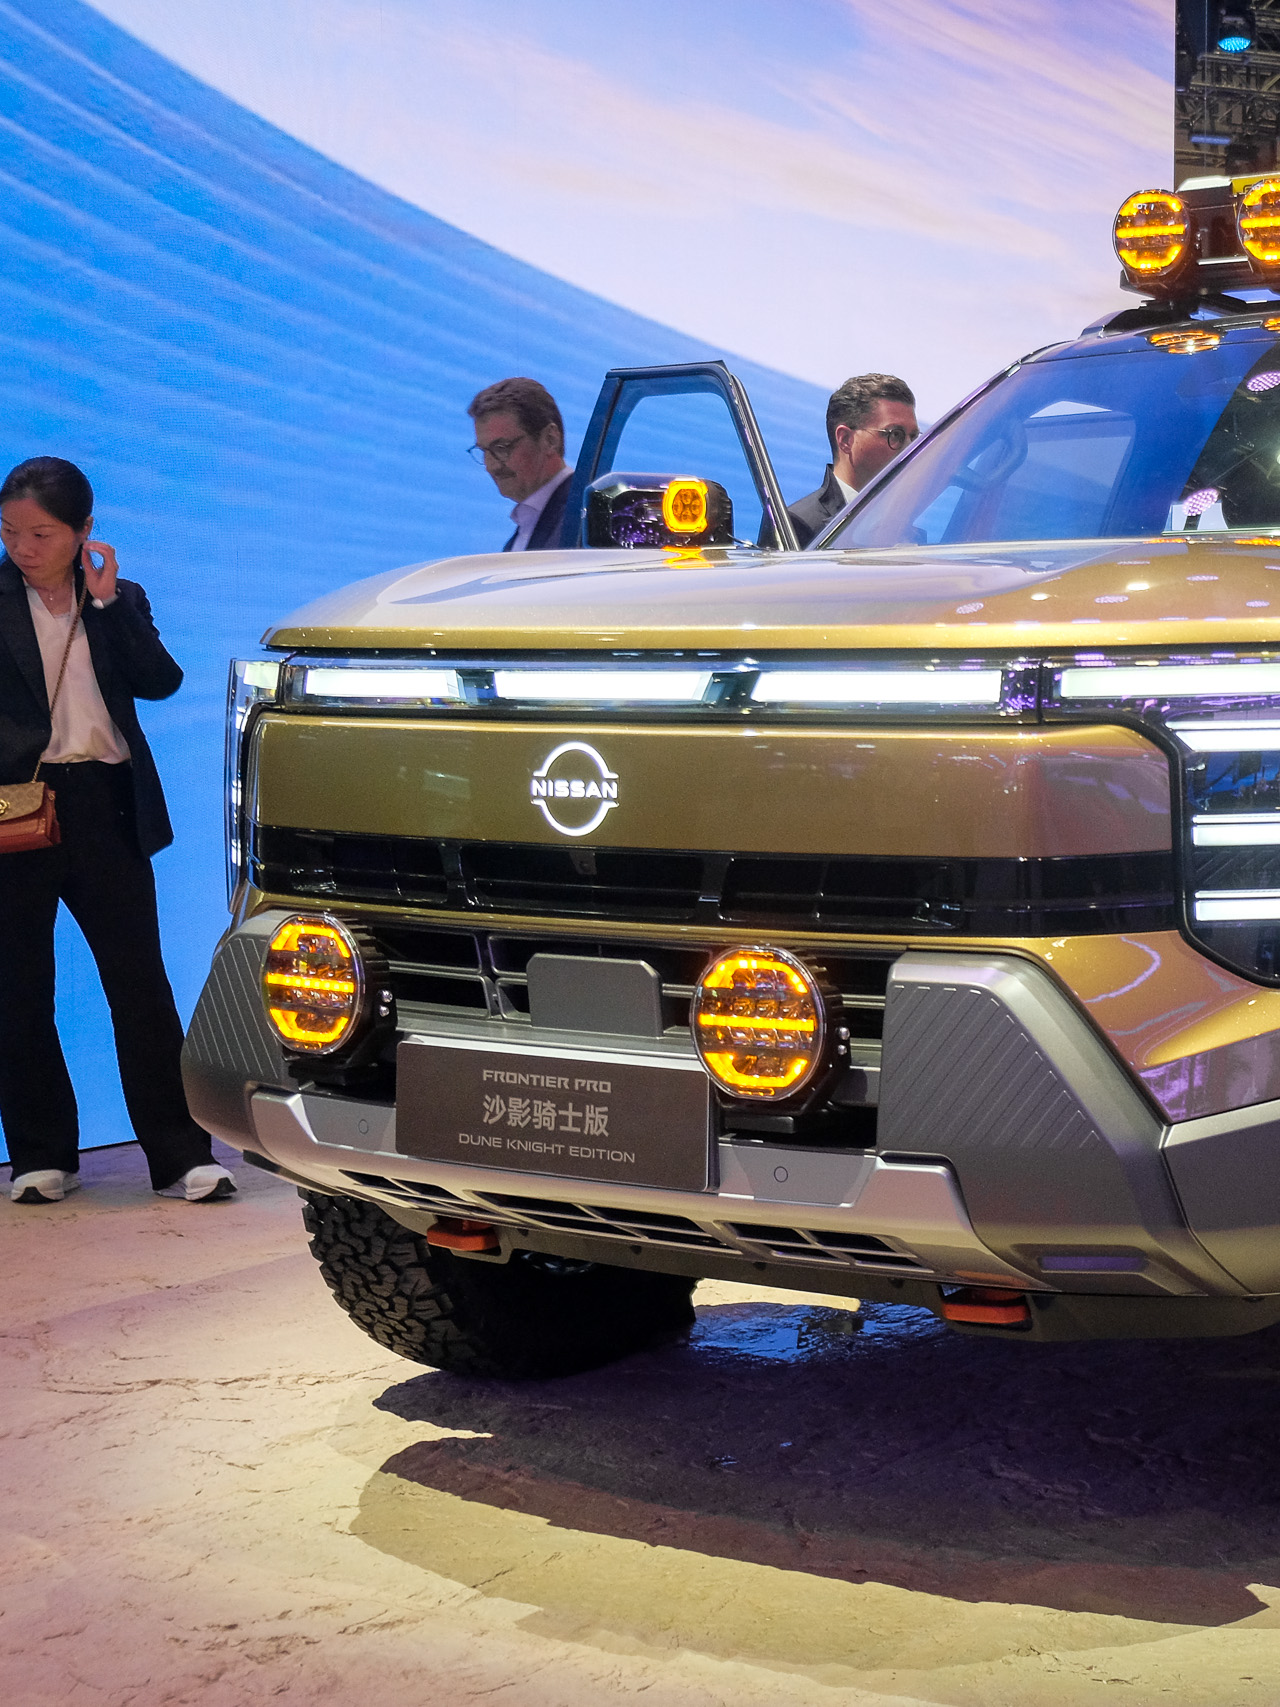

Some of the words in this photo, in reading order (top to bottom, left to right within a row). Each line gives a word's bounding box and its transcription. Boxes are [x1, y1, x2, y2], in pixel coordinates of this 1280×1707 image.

[530, 779, 618, 799] NISSAN
[483, 1069, 570, 1089] FRONTIER
[574, 1078, 612, 1093] PRO
[482, 1094, 610, 1138] 沙影骑士版
[458, 1133, 502, 1148] DUNE
[506, 1138, 565, 1155] KNIGHT
[569, 1145, 636, 1164] EDITION
